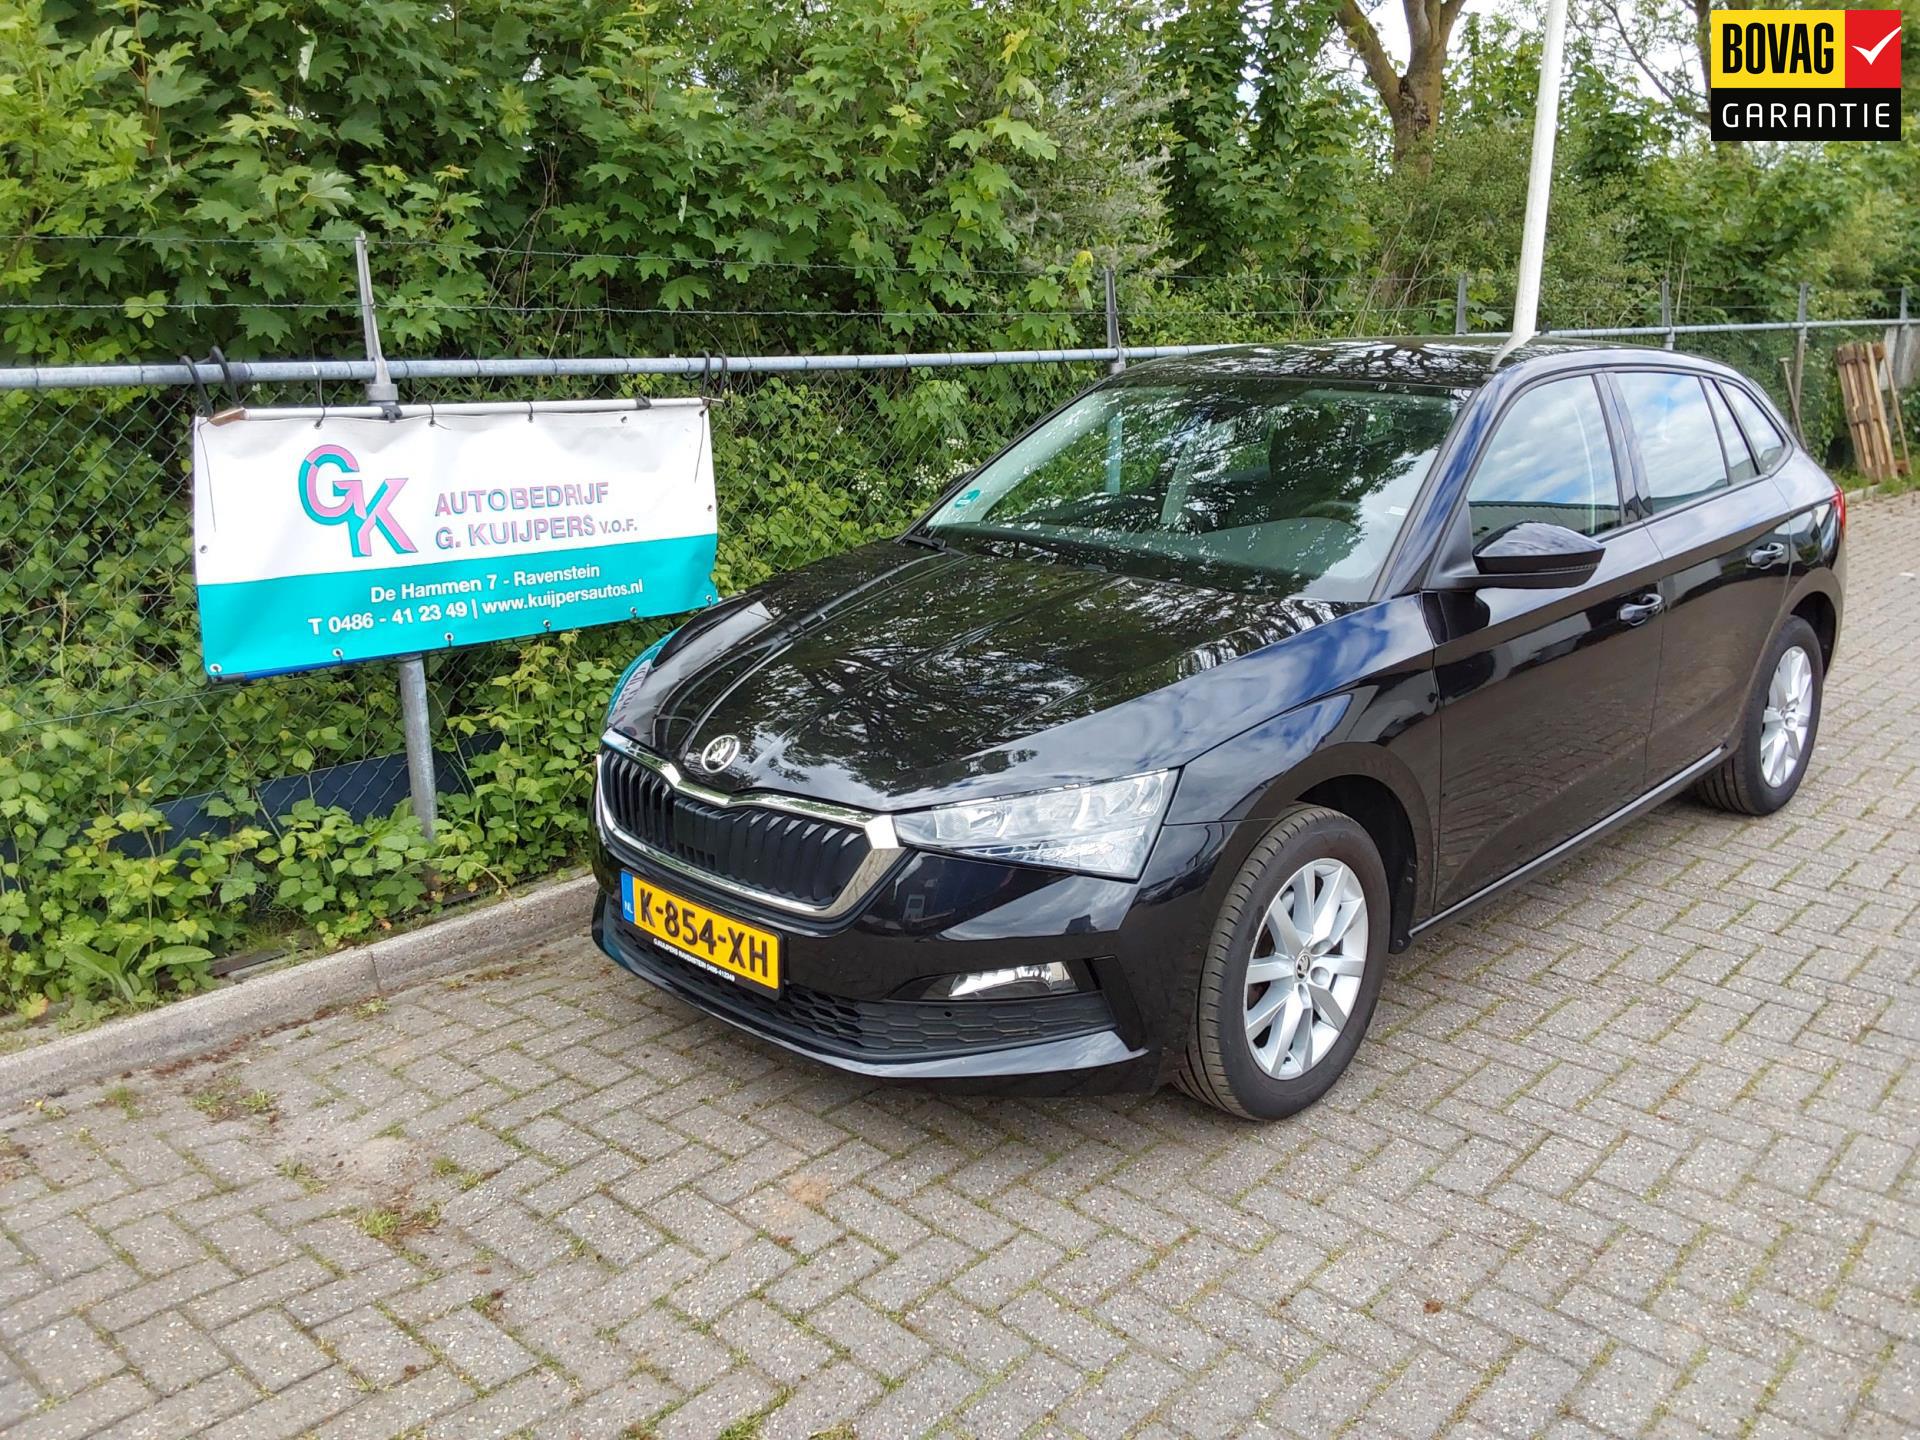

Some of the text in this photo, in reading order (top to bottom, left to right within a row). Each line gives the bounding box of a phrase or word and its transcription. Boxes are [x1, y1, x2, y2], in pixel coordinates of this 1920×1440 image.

[434, 482, 609, 516] AUTOBEDRIJF
[435, 526, 461, 550] G.
[467, 514, 596, 546] KUIJPERS
[370, 586, 396, 603] De
[401, 578, 482, 600] Hammen
[486, 574, 498, 590] 7
[513, 563, 600, 587] Ravenstein
[307, 617, 323, 635] T
[328, 612, 374, 633] 0486
[391, 607, 414, 625] 41
[418, 604, 442, 622] 23
[445, 601, 468, 618] 49
[481, 578, 644, 614] www.kuijpersautos.nl
[640, 887, 768, 978] K-854-XH
